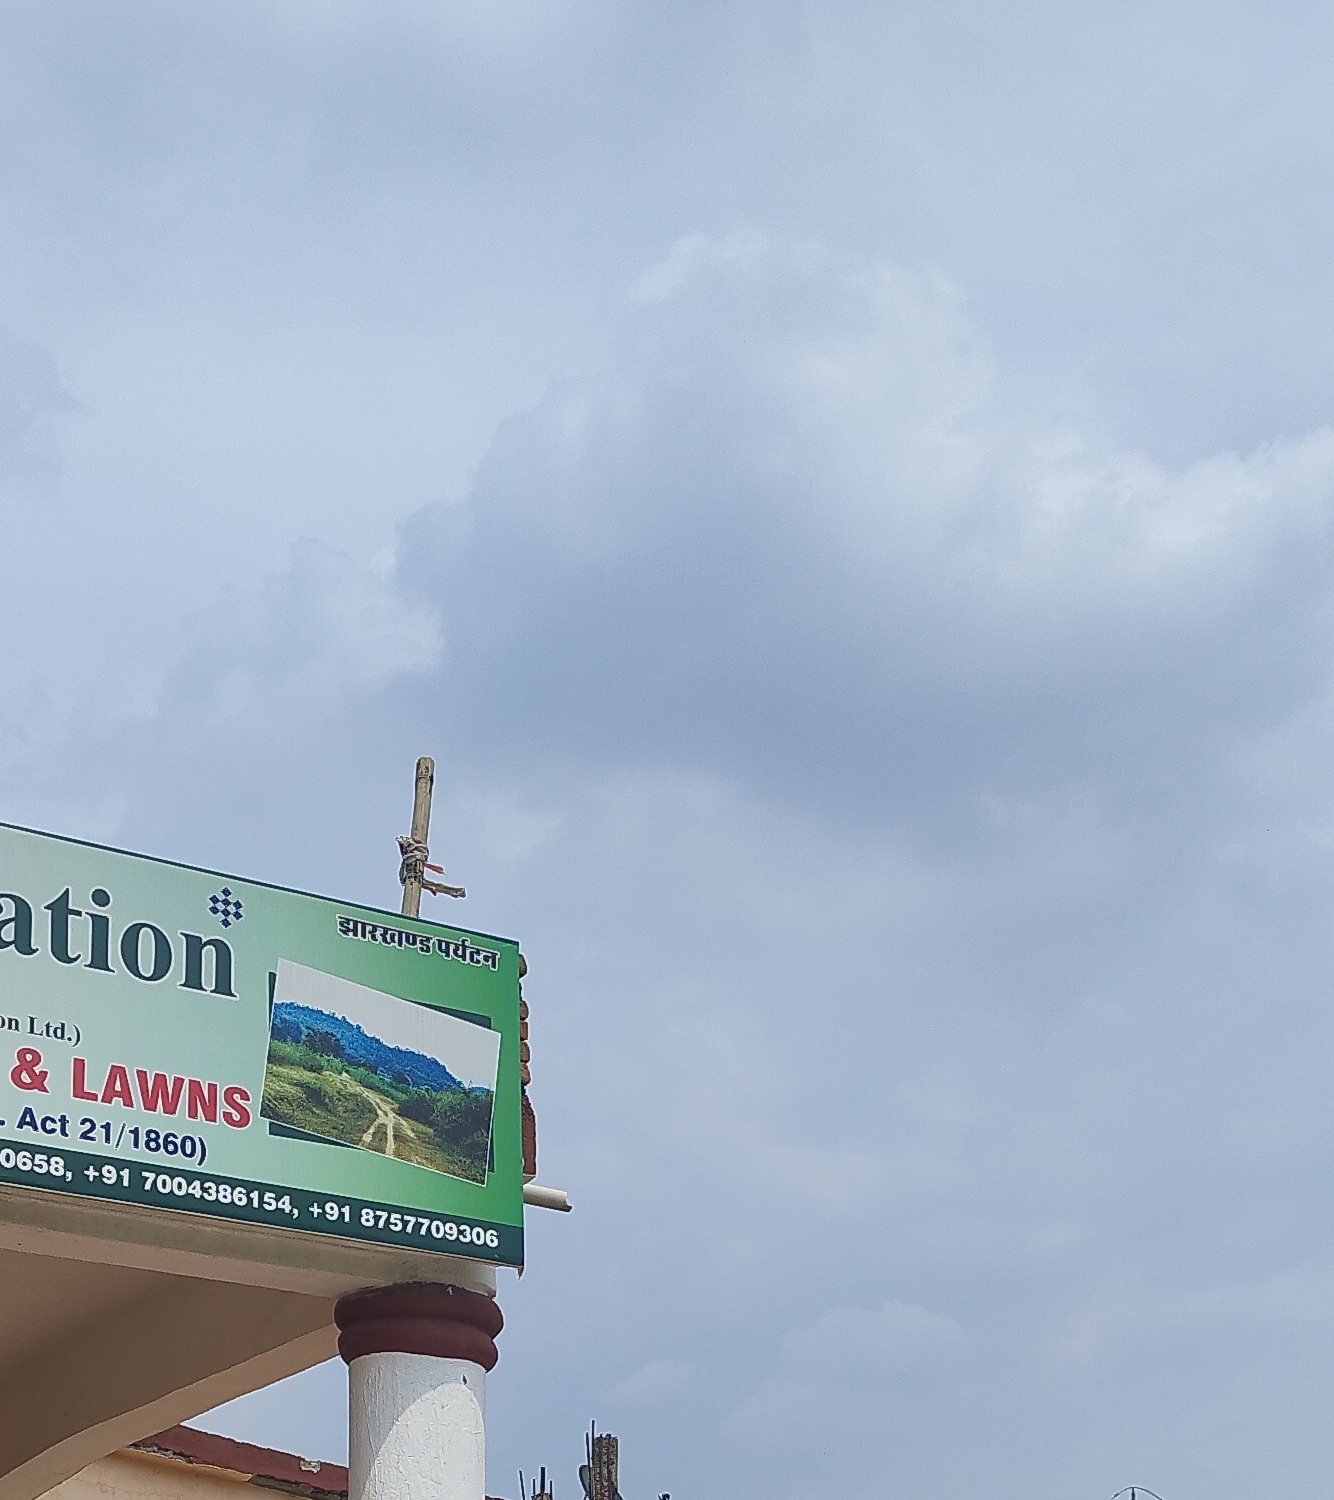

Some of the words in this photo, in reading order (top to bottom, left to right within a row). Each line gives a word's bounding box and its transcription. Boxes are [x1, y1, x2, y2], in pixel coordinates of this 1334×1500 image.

[336, 915, 433, 956] झारखण्ड
[435, 933, 499, 971] पर्यटन
[27, 1012, 82, 1047] Ltd.)
[9, 1045, 50, 1095] &
[72, 1055, 253, 1129] LAWNS
[15, 1109, 70, 1142] Act
[77, 1117, 208, 1168] 21/1860)
[83, 1165, 132, 1188] +91
[140, 1171, 299, 1221] 7004386154,
[307, 1201, 352, 1225] +91
[359, 1208, 500, 1248] 8757709306
